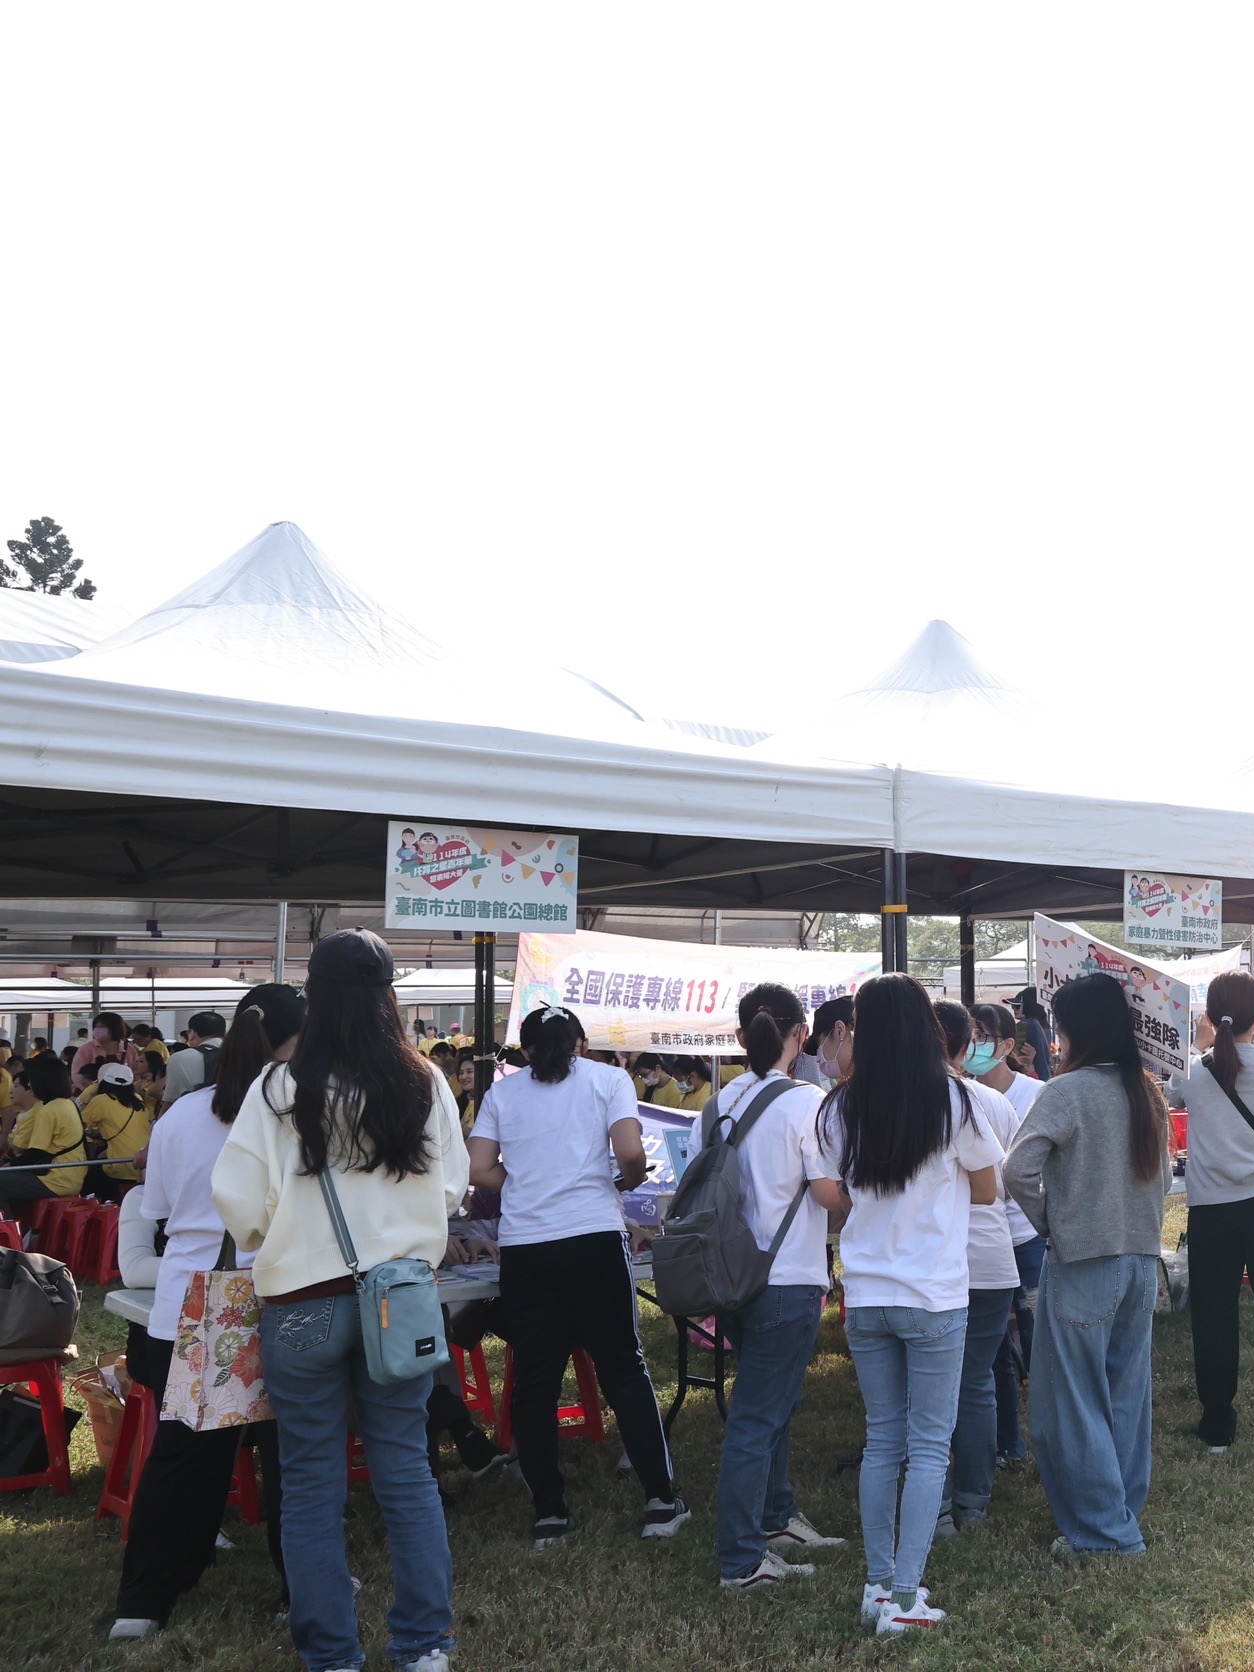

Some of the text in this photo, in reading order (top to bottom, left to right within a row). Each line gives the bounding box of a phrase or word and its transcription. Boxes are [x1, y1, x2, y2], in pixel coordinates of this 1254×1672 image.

[431, 846, 468, 863] 114年度
[394, 896, 568, 922] 臺南市立圖書館公園總館
[1181, 915, 1219, 930] 臺南市政府
[1128, 925, 1219, 944] 家庭暴力暨性侵害防治中心
[562, 967, 719, 1014] 全國保護專線113
[650, 1031, 740, 1047] 臺南市政府家庭暴
